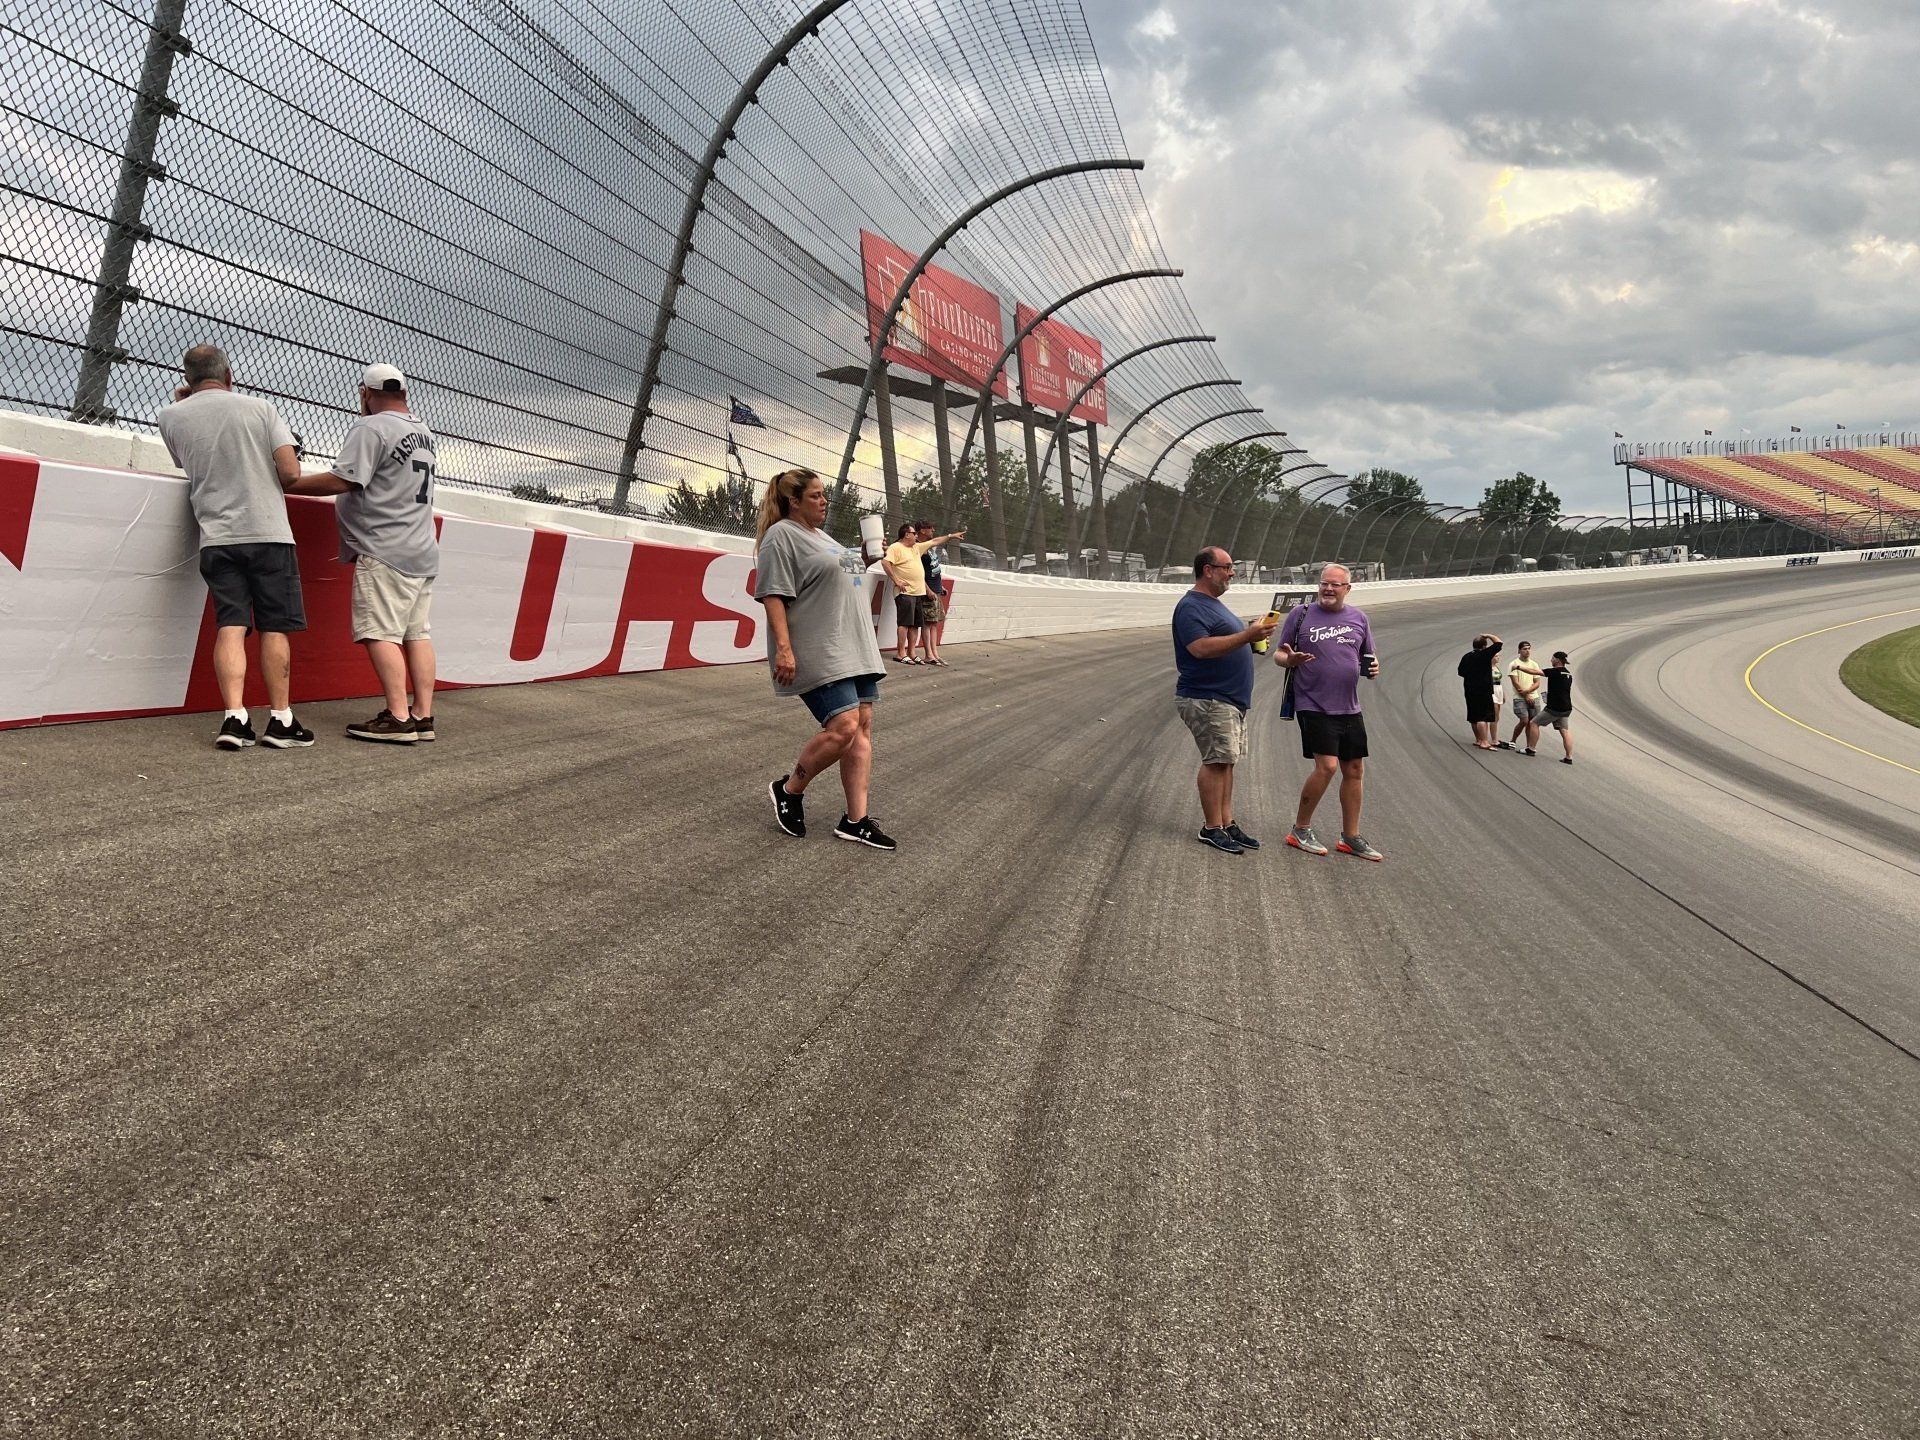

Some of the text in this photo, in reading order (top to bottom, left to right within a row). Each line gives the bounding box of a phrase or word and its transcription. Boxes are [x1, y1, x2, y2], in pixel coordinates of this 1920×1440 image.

[411, 459, 435, 506] 7
[1870, 549, 1906, 560] MICHIGAN
[1309, 625, 1353, 643] Tootsies
[1336, 636, 1356, 644] Racing
